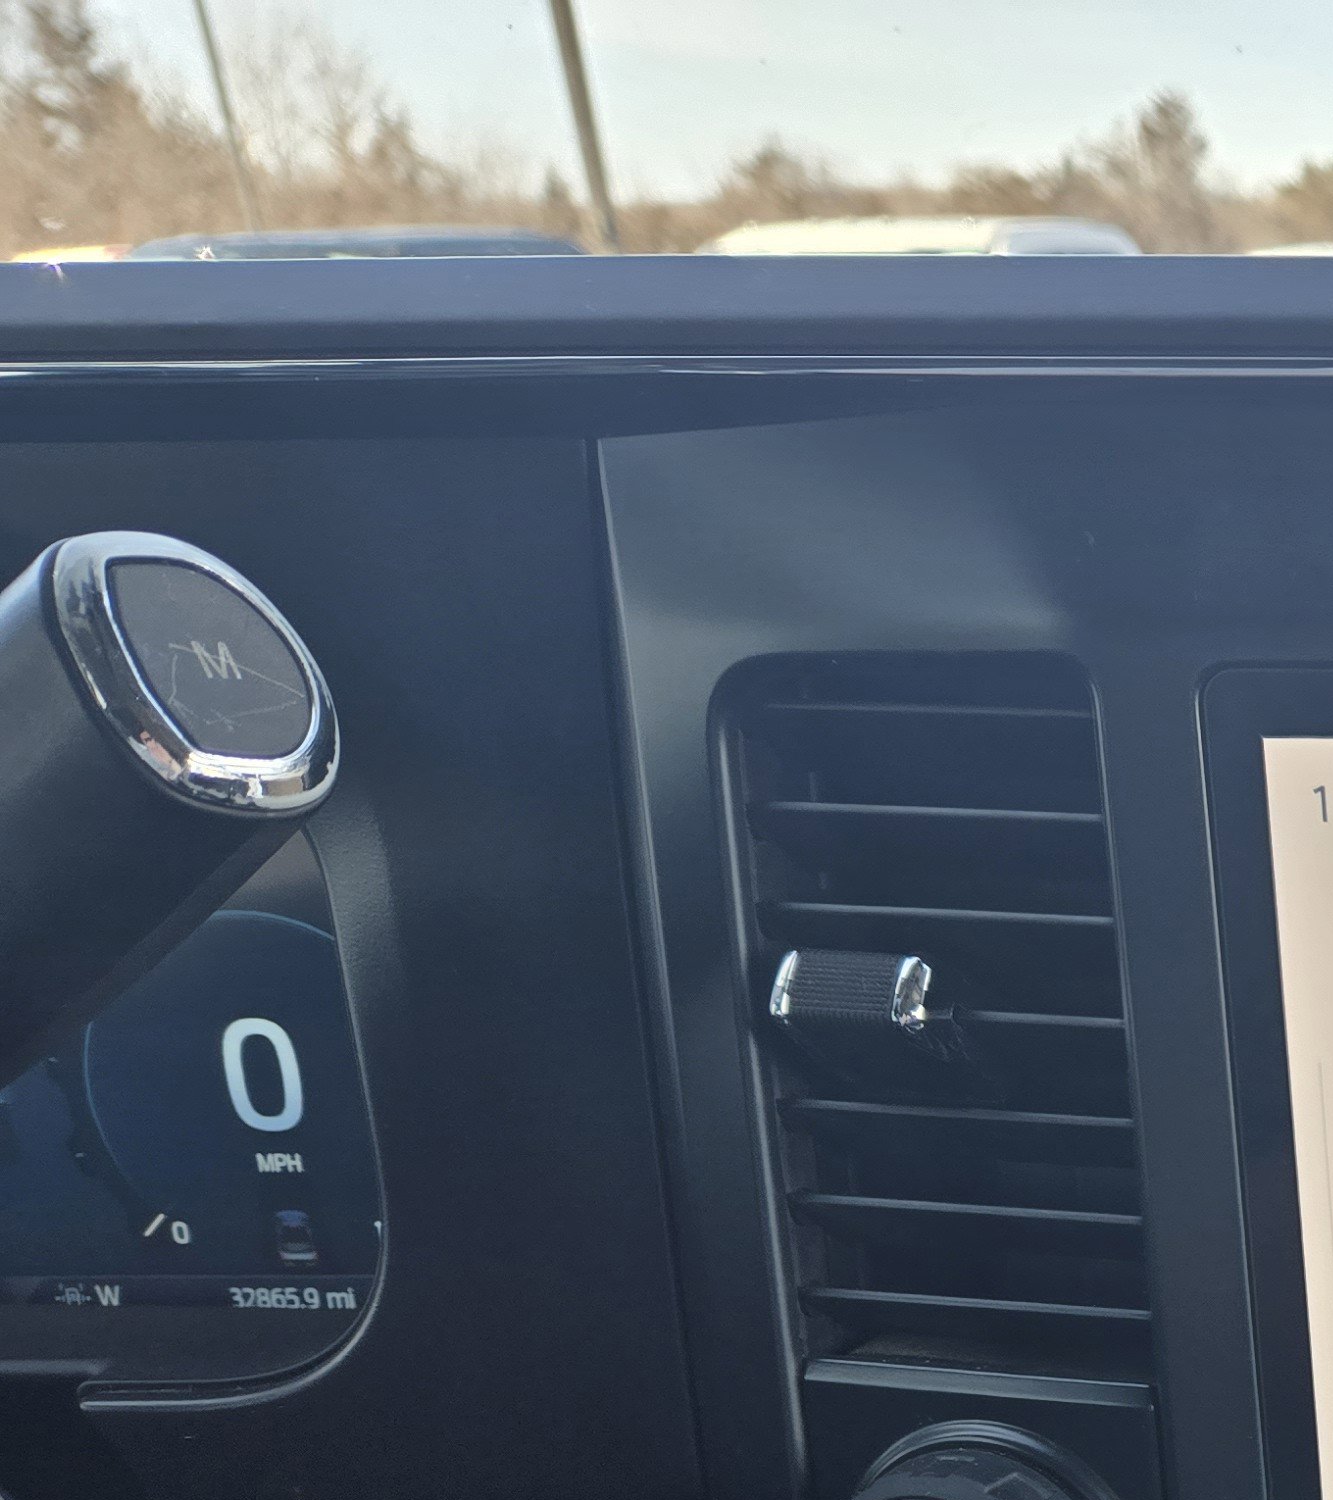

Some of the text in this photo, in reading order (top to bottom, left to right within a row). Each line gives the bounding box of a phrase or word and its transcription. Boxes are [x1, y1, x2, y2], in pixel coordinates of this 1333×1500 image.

[221, 1017, 304, 1132] 0
[255, 1152, 303, 1173] MPH
[171, 1220, 191, 1245] 0
[94, 1284, 120, 1307] W
[228, 1286, 357, 1311] 32865.9 mi
